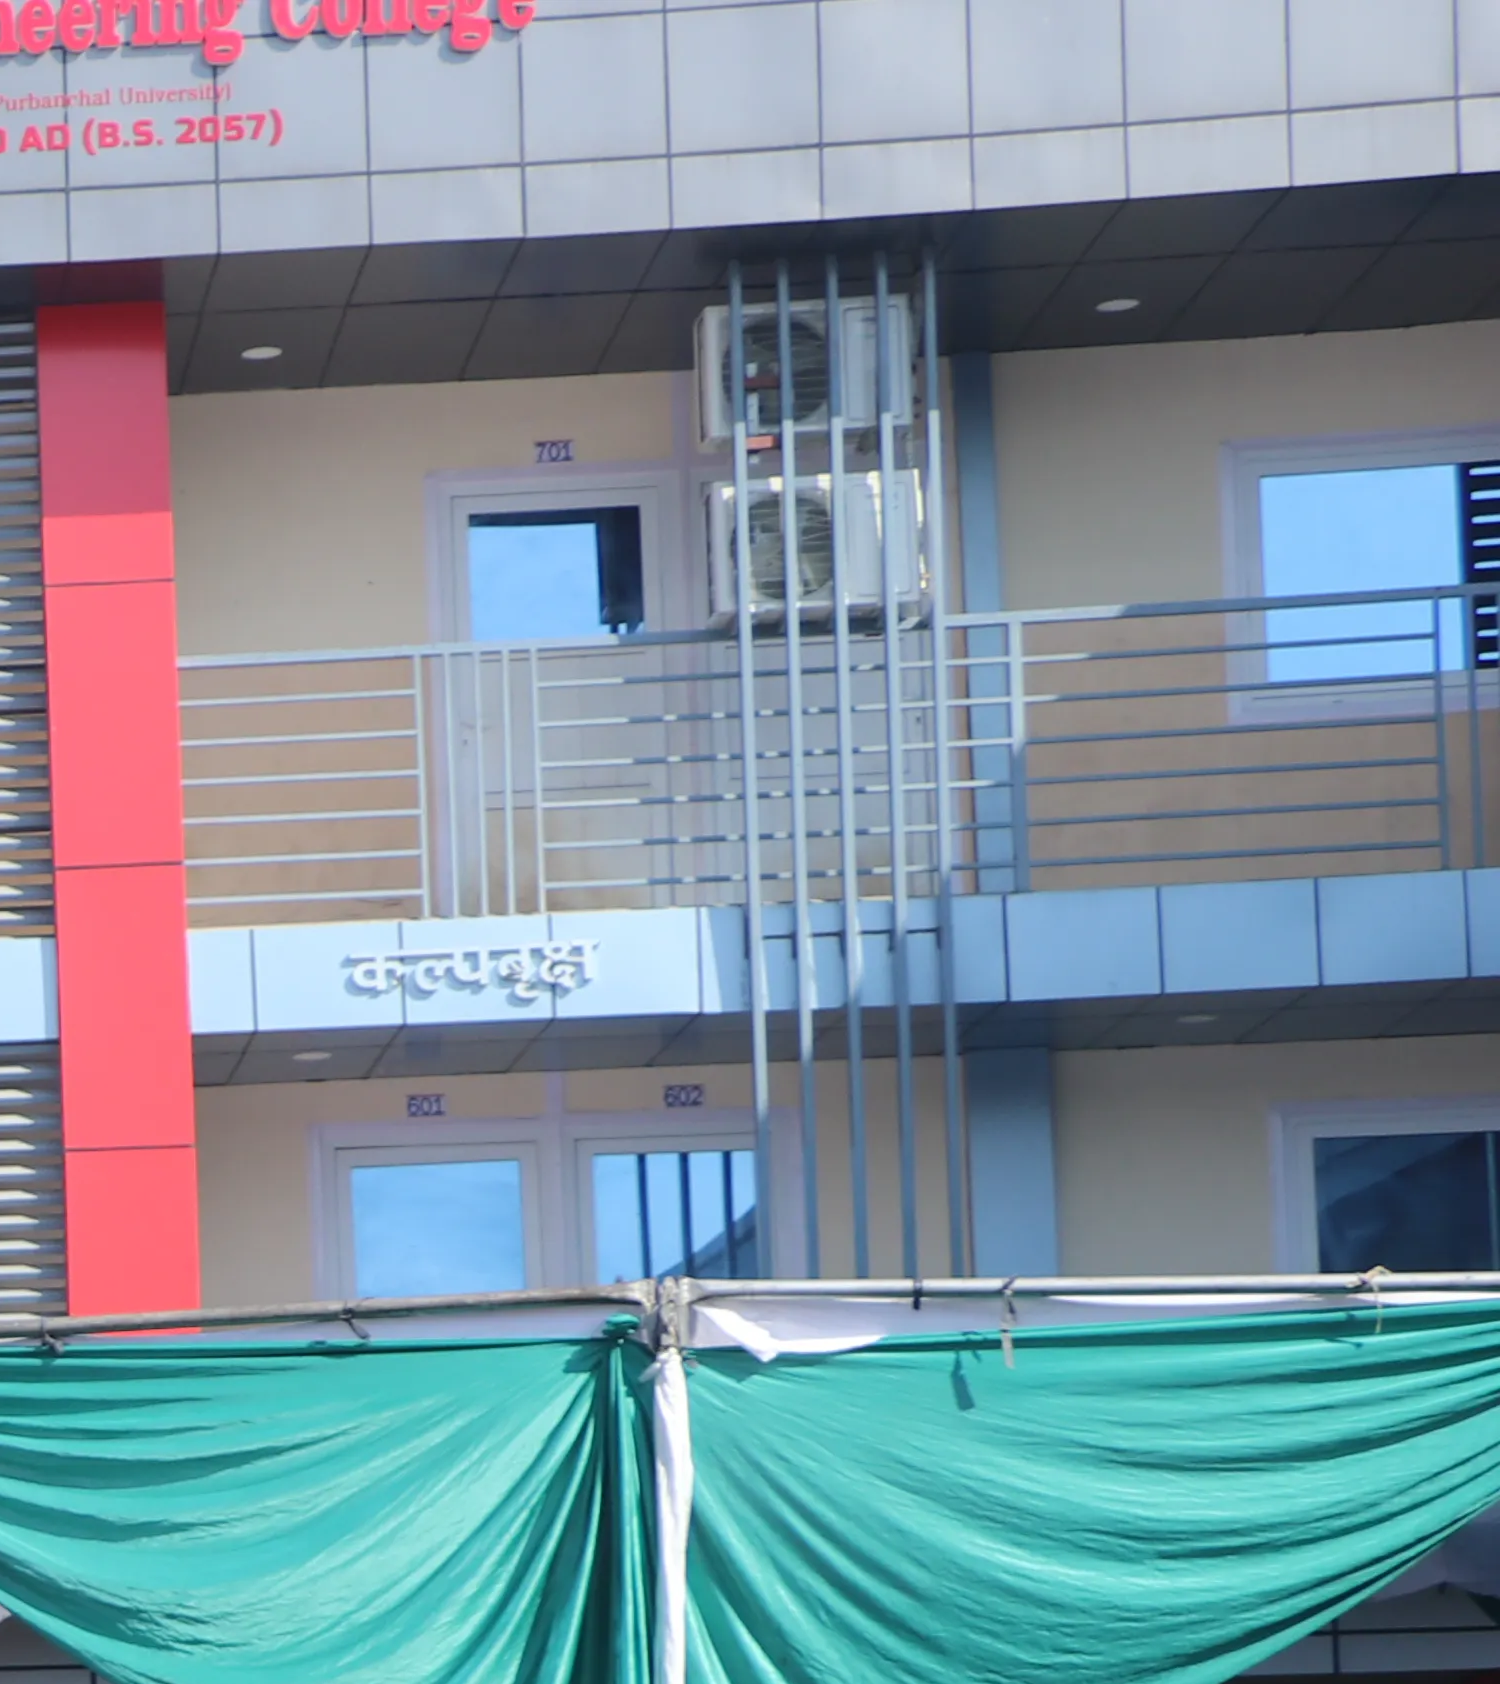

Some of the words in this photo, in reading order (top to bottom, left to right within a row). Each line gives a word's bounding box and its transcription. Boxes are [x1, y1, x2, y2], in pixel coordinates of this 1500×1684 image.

[119, 83, 232, 105] University)
[20, 123, 72, 152] AD
[82, 117, 164, 156] (B.S.
[174, 108, 284, 147] 2057)
[534, 440, 574, 462] 701
[407, 1095, 445, 1117] 601
[664, 1085, 703, 1107] 602
